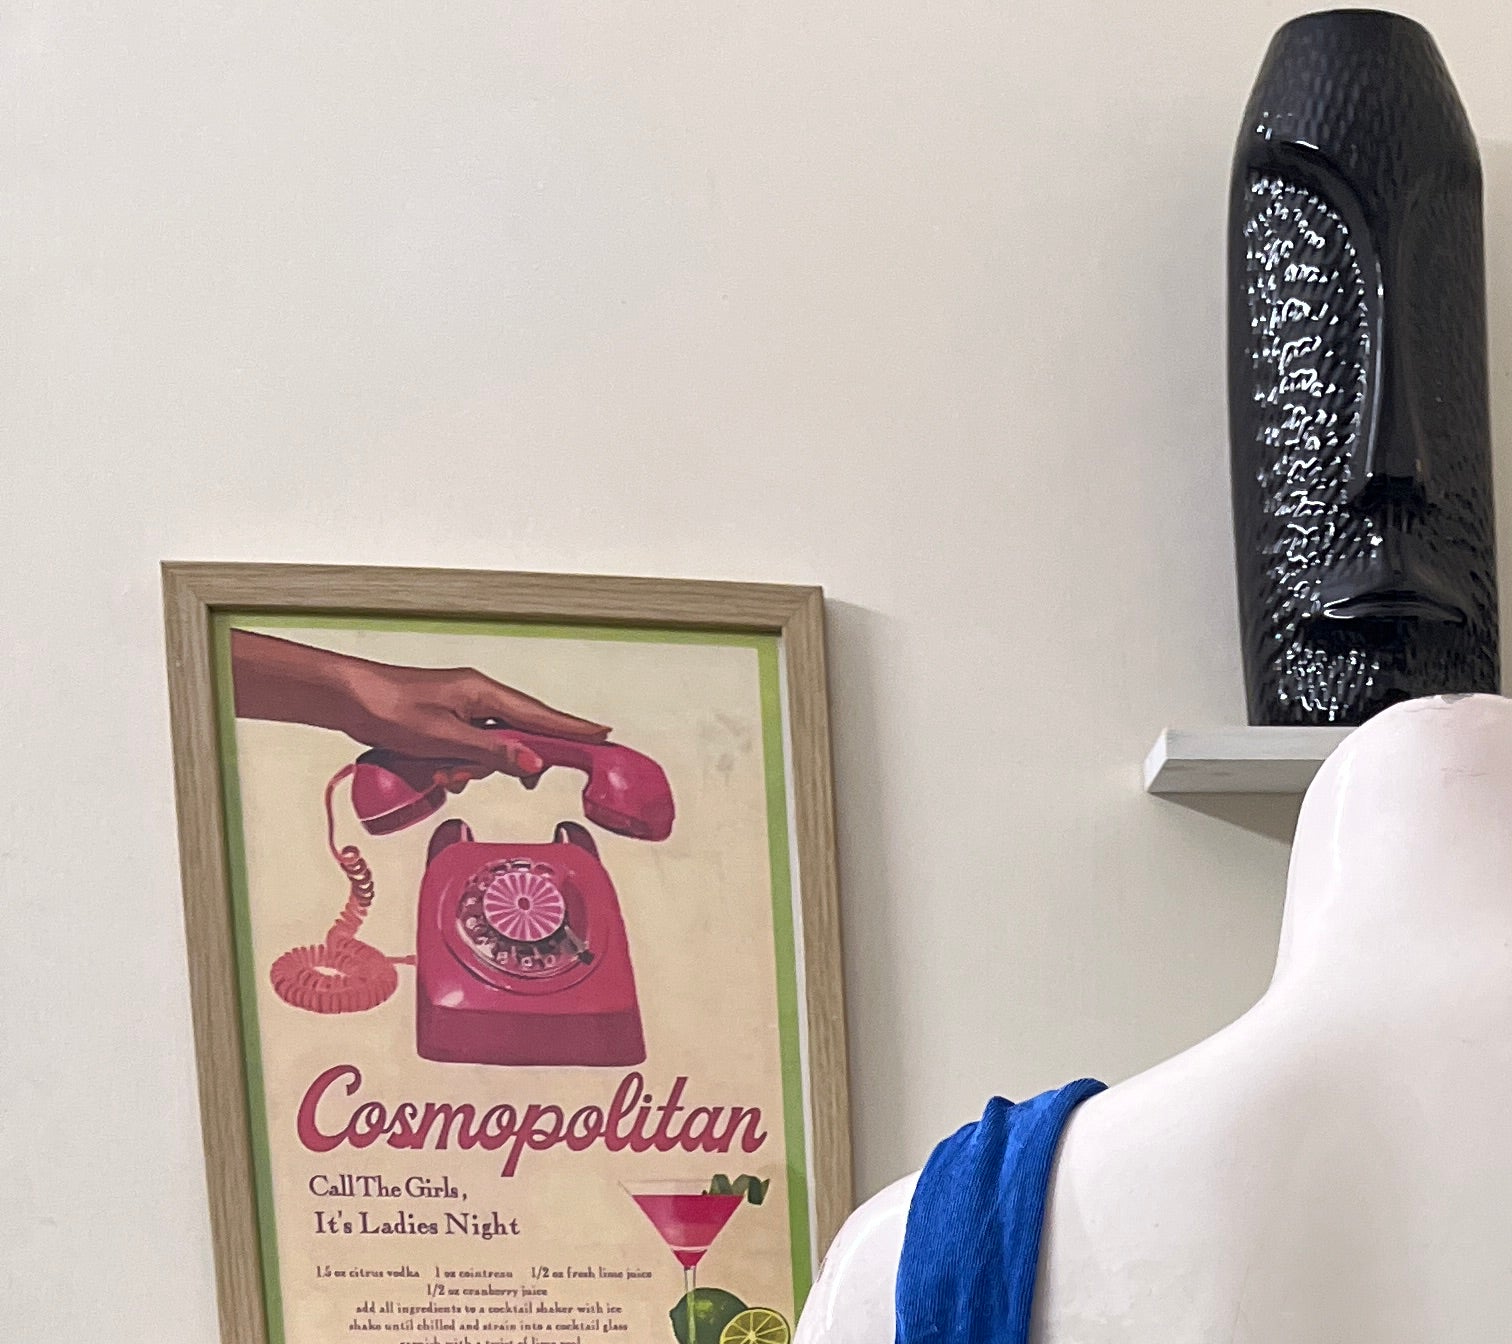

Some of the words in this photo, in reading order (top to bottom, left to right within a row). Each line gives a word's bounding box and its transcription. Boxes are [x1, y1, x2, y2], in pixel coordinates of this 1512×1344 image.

[296, 1064, 768, 1178] Cosmopolitan
[309, 1174, 354, 1197] Call
[356, 1175, 402, 1198] The
[315, 1210, 352, 1234] It's
[359, 1210, 438, 1234] Ladies
[444, 1211, 520, 1240] Night
[334, 1270, 346, 1278] oz
[349, 1266, 383, 1278] citrus
[386, 1265, 420, 1278] vodka
[435, 1265, 440, 1278] 1
[444, 1270, 456, 1278] oz
[459, 1267, 513, 1278] cointreau
[531, 1265, 549, 1280] 1/2
[567, 1266, 595, 1278] fresh
[598, 1266, 623, 1278] lime
[627, 1267, 652, 1279] juice
[427, 1283, 445, 1297] 1/2
[463, 1284, 518, 1297] cranberry
[521, 1285, 548, 1297] juice
[356, 1300, 375, 1313] add
[379, 1300, 393, 1313] all
[397, 1301, 461, 1315] ingredients
[465, 1305, 476, 1313] to
[488, 1301, 532, 1314] cocktail
[536, 1301, 573, 1314] shaker
[577, 1301, 603, 1314] with
[606, 1302, 622, 1314] ice
[349, 1318, 382, 1331] shake
[385, 1318, 413, 1331] until
[417, 1318, 455, 1331] chilled
[459, 1318, 479, 1331] and
[482, 1320, 516, 1331] strain
[520, 1320, 543, 1331] into
[555, 1319, 599, 1331] cocktail
[603, 1319, 628, 1333] glass
